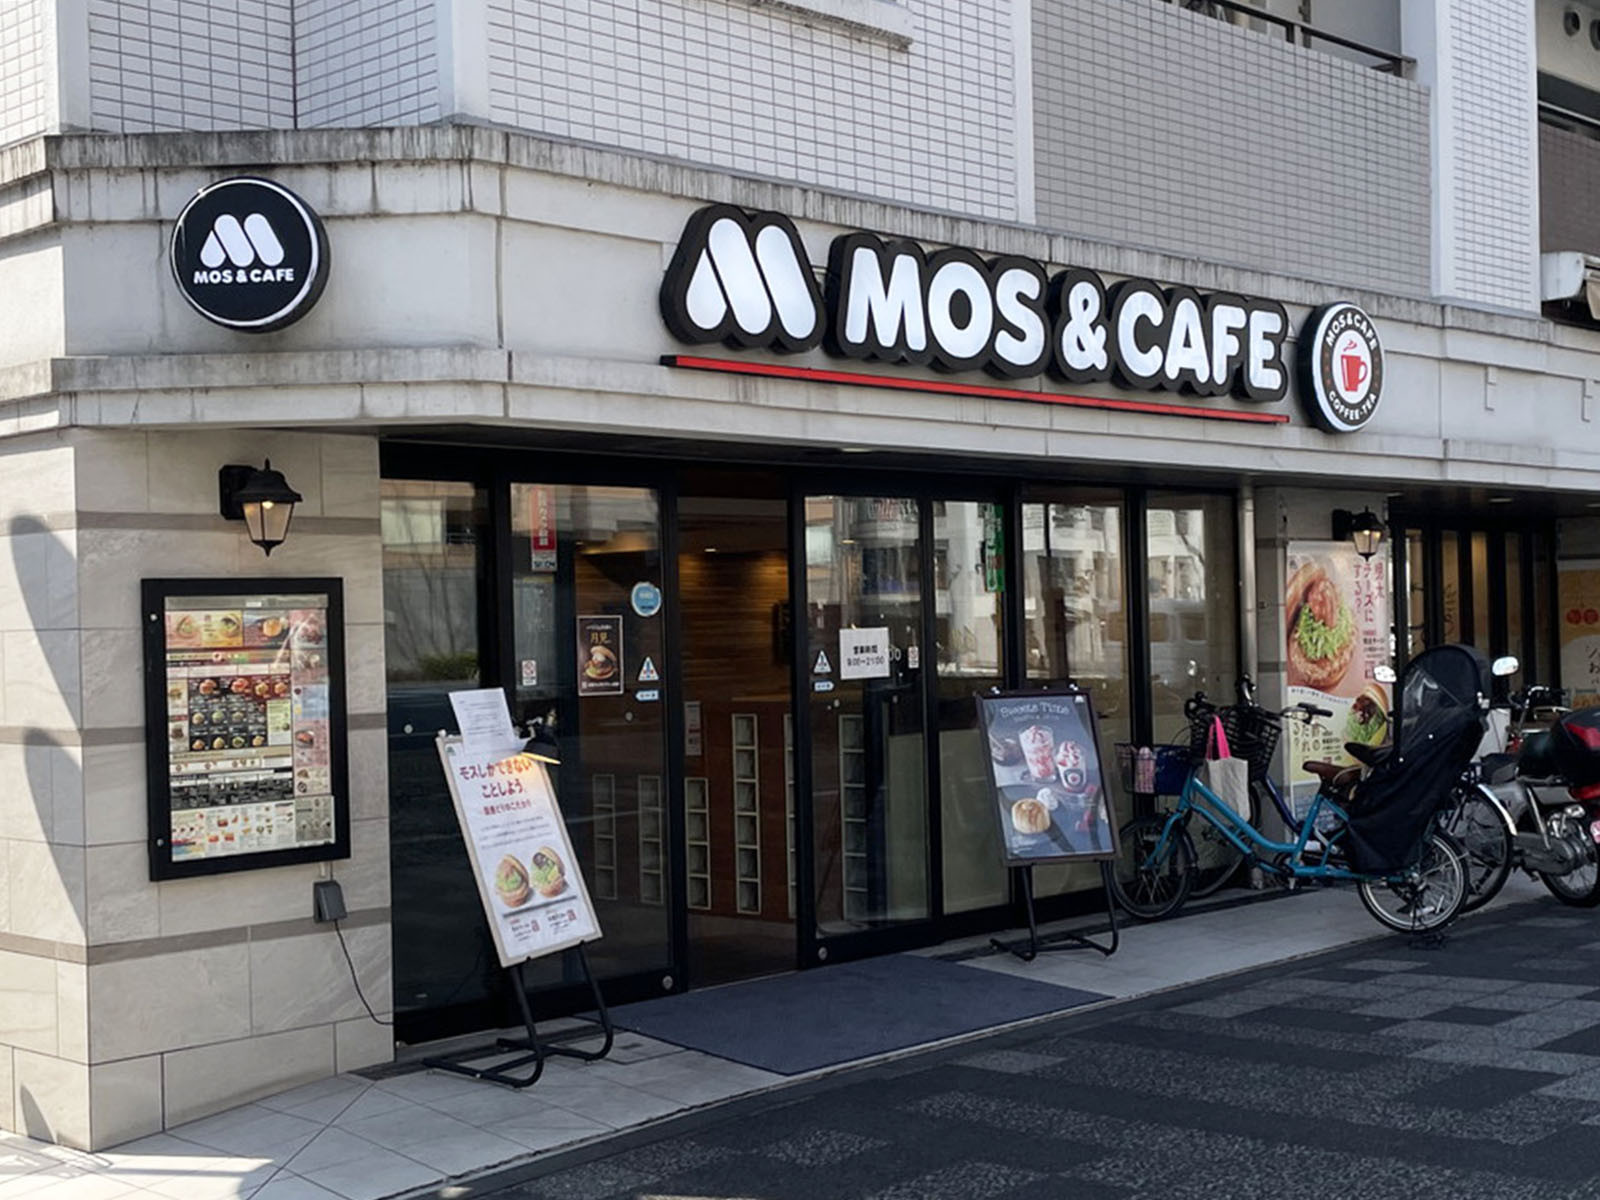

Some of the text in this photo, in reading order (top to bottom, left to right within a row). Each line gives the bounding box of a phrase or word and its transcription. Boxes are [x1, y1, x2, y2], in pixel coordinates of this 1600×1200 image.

[845, 247, 1046, 366] MOS
[1118, 290, 1283, 391] CAFE
[459, 758, 533, 780] モスしかできない
